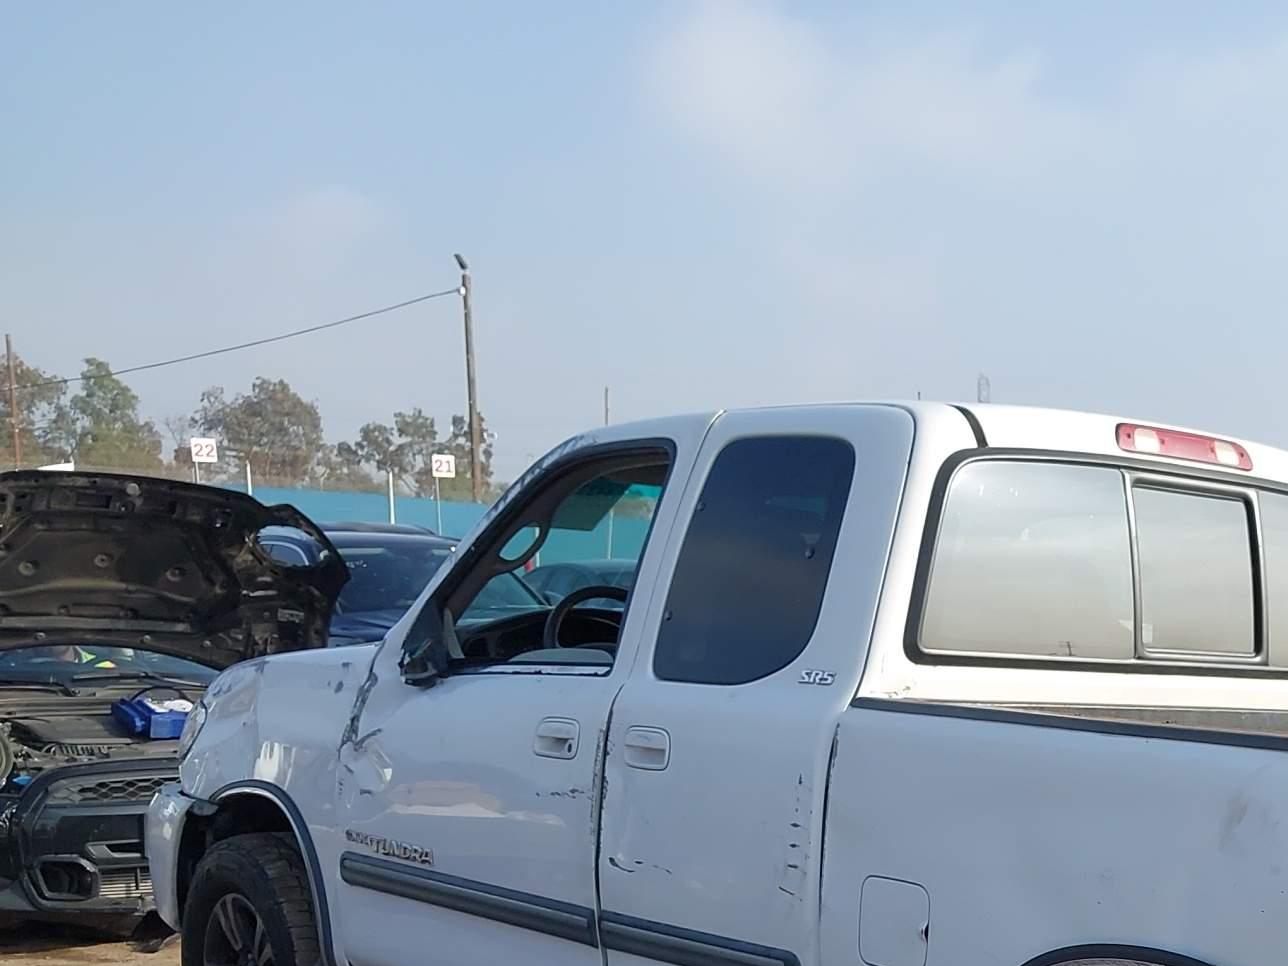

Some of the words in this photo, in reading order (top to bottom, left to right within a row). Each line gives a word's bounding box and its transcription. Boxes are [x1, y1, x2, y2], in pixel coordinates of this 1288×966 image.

[193, 443, 216, 458] 22
[434, 459, 454, 473] 21
[368, 836, 434, 866] TUNDRA
